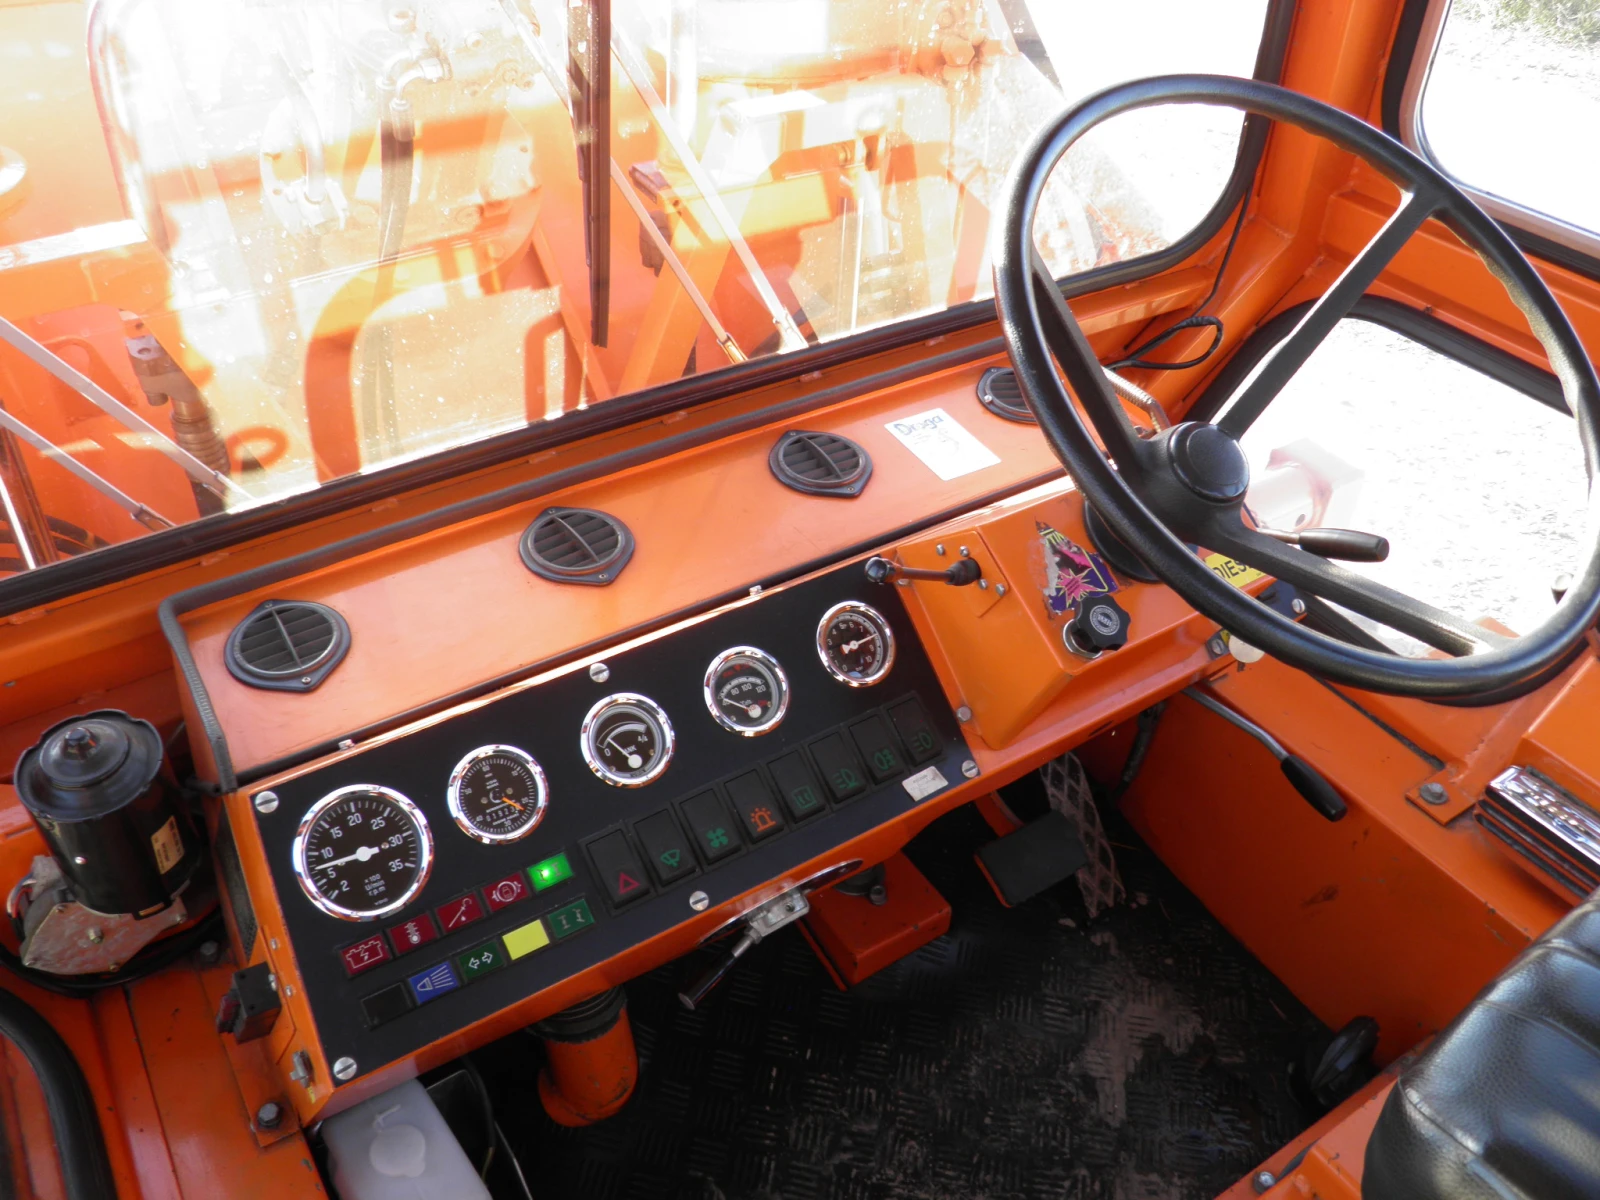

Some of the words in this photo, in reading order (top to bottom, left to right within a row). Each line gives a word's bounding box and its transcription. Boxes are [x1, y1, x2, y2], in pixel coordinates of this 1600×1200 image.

[1211, 560, 1252, 580] DIES
[731, 687, 739, 695] 80
[741, 683, 752, 691] 100
[756, 684, 766, 693] 120
[604, 748, 611, 757] 0
[347, 813, 362, 826] 20
[370, 816, 385, 830] 25
[330, 826, 342, 839] 15
[388, 834, 403, 847] 30
[321, 847, 333, 859] 10
[388, 859, 403, 872] 35
[327, 868, 336, 878] 5
[340, 880, 349, 891] 2
